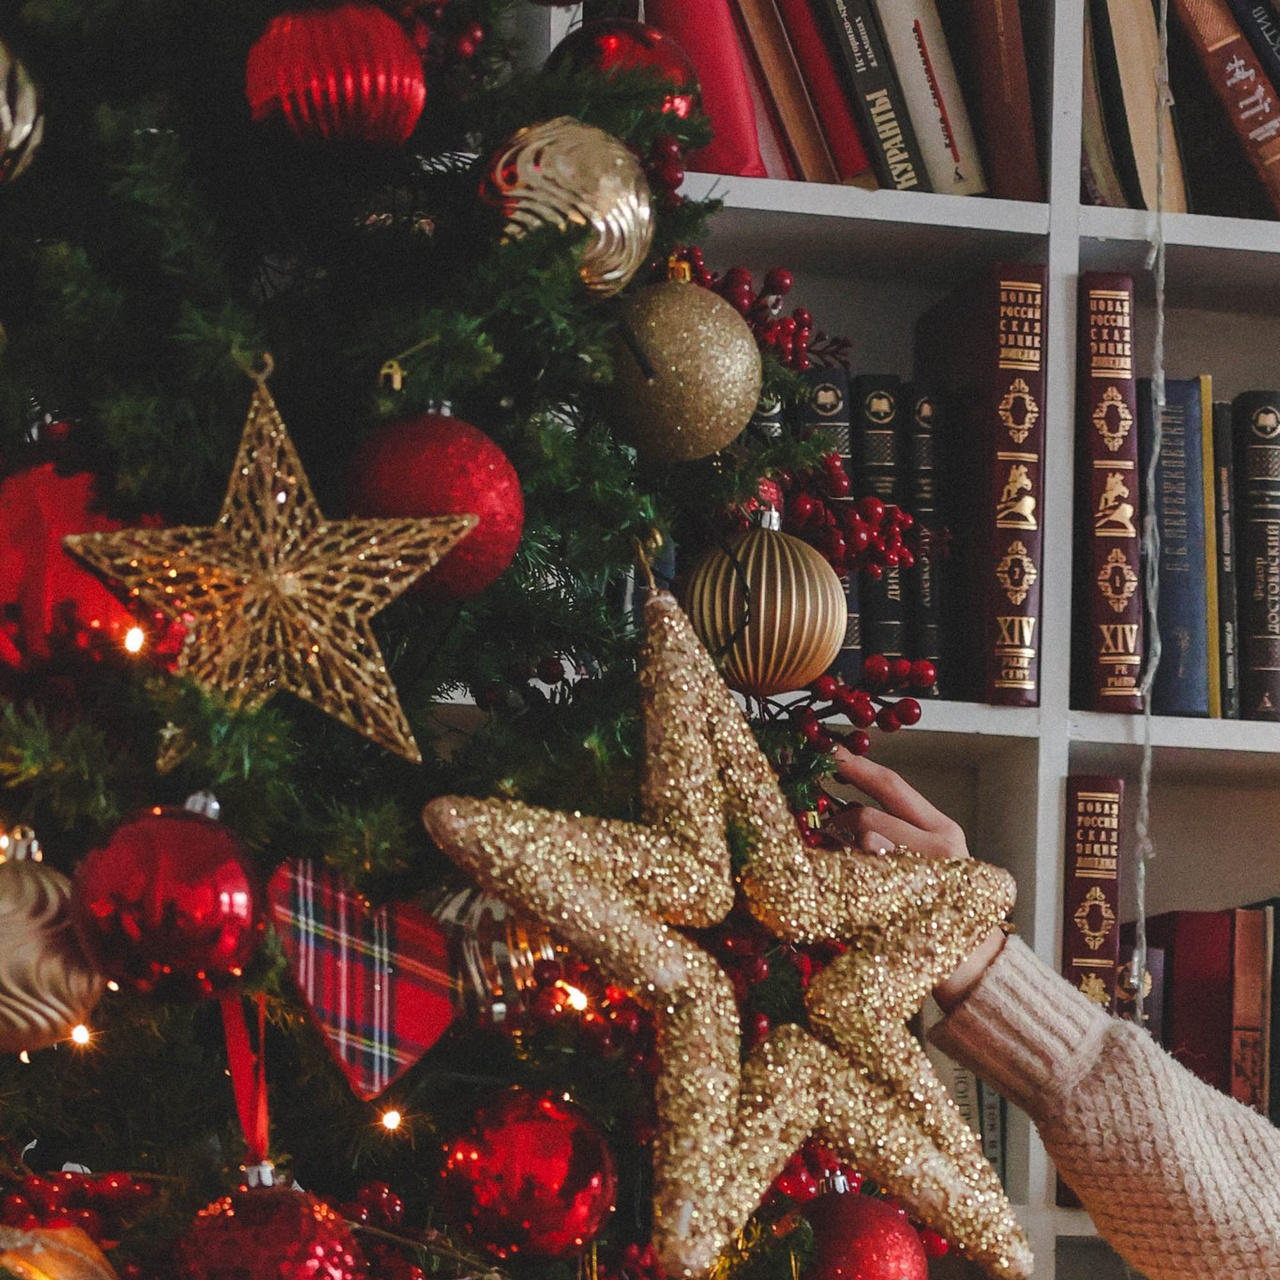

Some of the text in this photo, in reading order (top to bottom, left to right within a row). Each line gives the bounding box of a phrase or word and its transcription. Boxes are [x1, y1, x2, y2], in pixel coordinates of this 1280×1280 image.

[861, 86, 922, 191] КУРАНТЫ
[1001, 291, 1042, 305] НОВАЯ
[1000, 305, 1041, 320] РОССИЙ
[1090, 300, 1130, 314] НОВАЯ
[1000, 319, 1041, 333] СКАЯ
[1091, 313, 1130, 328] РОССИЙ
[1091, 328, 1131, 341] СКАЯ
[996, 616, 1036, 647] XIV
[1100, 624, 1139, 654] XIV
[1078, 802, 1119, 815] НОВАЯ
[1077, 813, 1118, 829] РОССИЙ
[1076, 829, 1118, 843] СКАЯ
